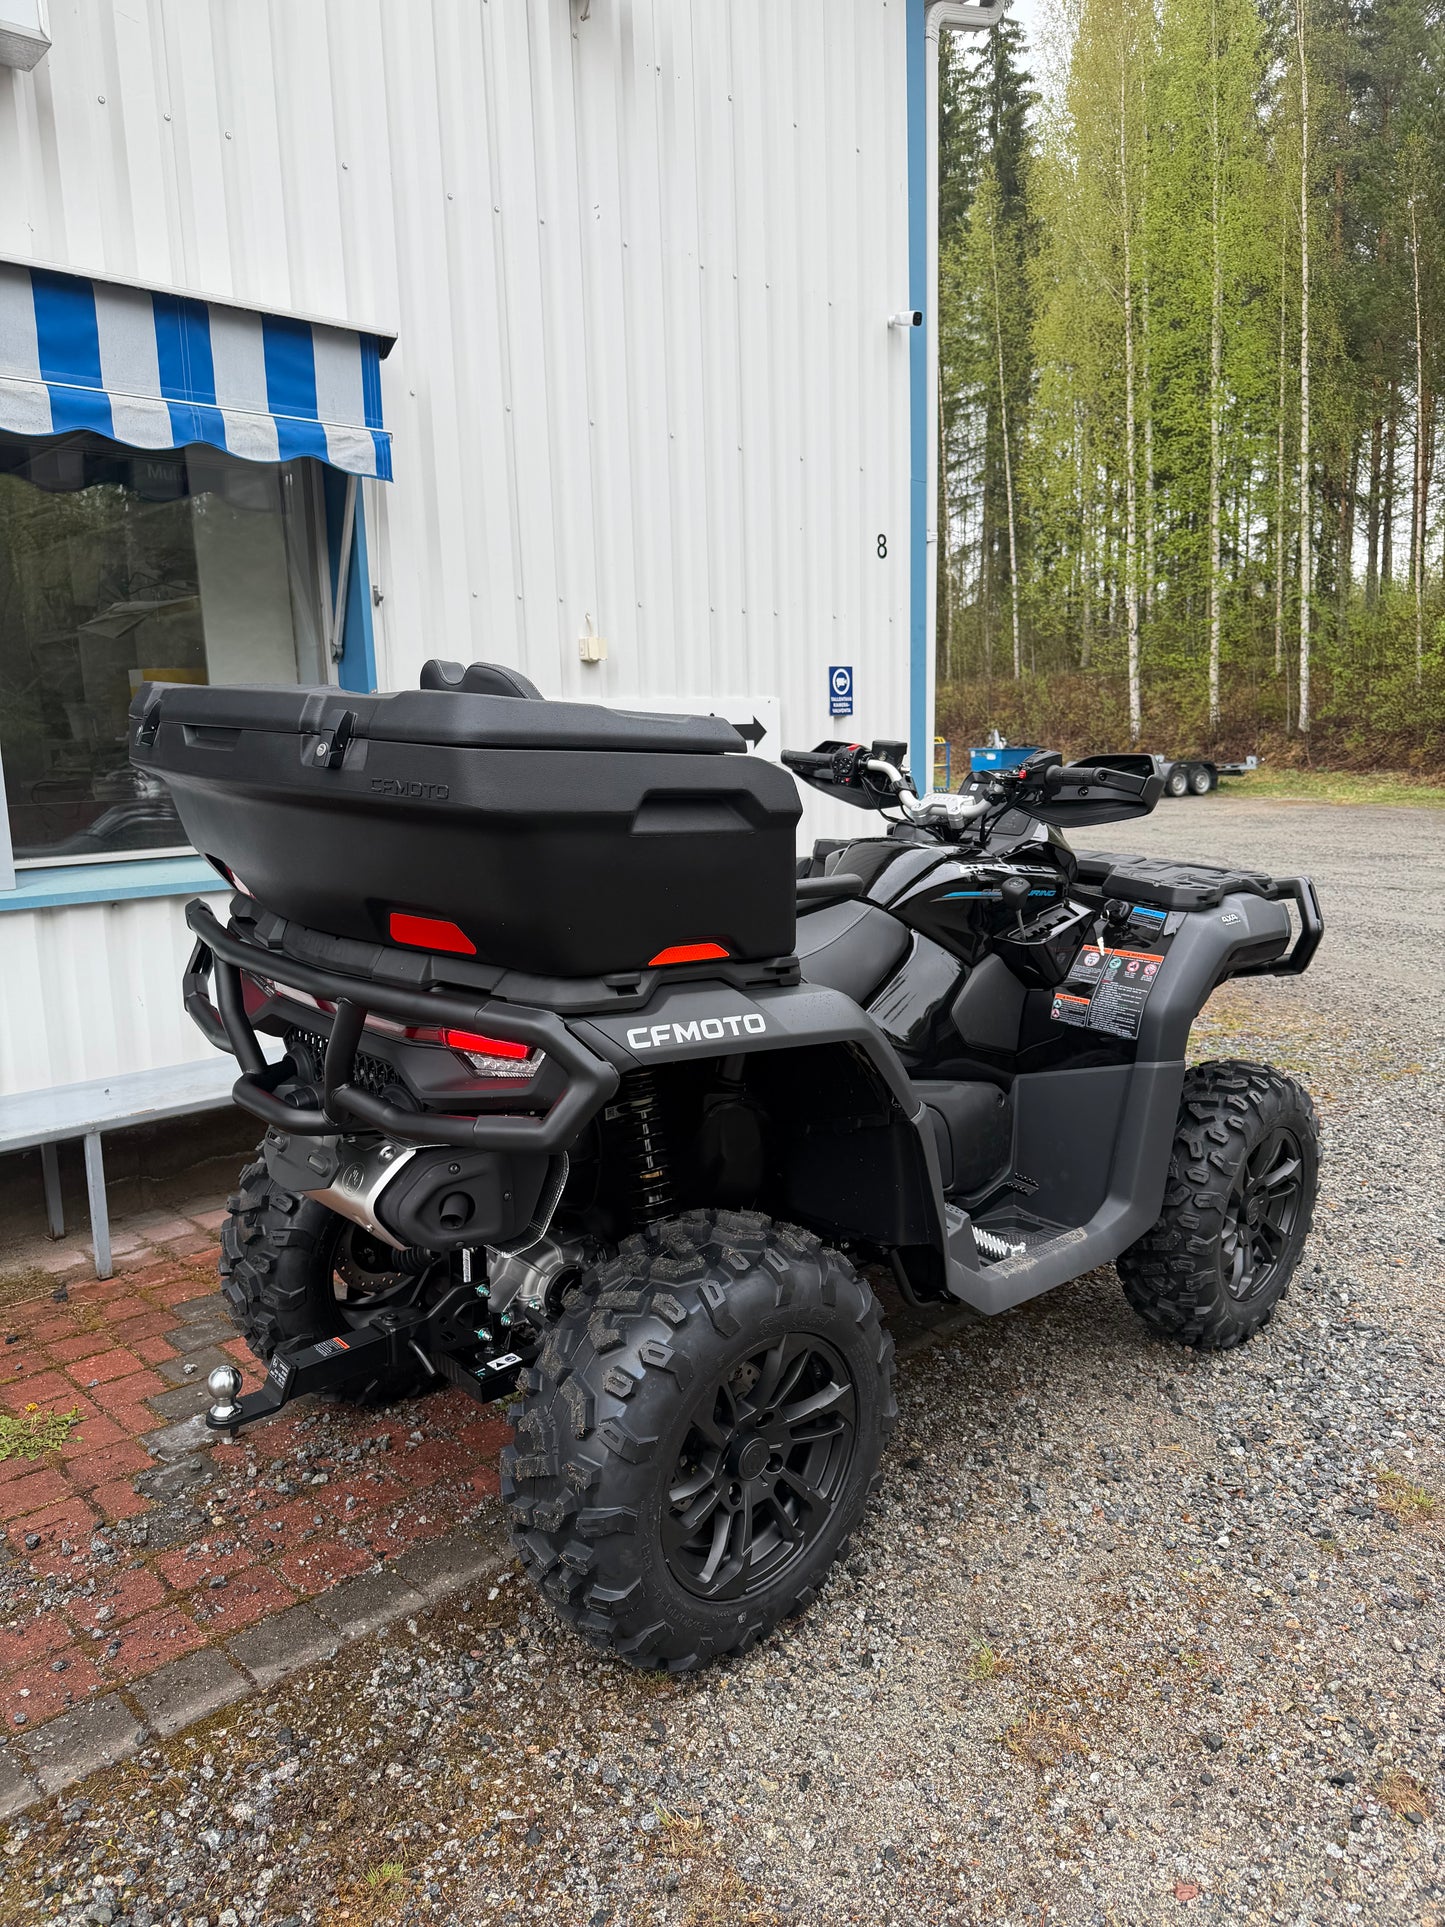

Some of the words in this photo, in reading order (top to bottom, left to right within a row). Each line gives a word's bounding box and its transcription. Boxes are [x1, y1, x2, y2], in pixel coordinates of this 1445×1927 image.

[877, 533, 888, 559] 8
[371, 777, 450, 800] CFMOTO
[626, 1013, 767, 1050] CFMOTO
